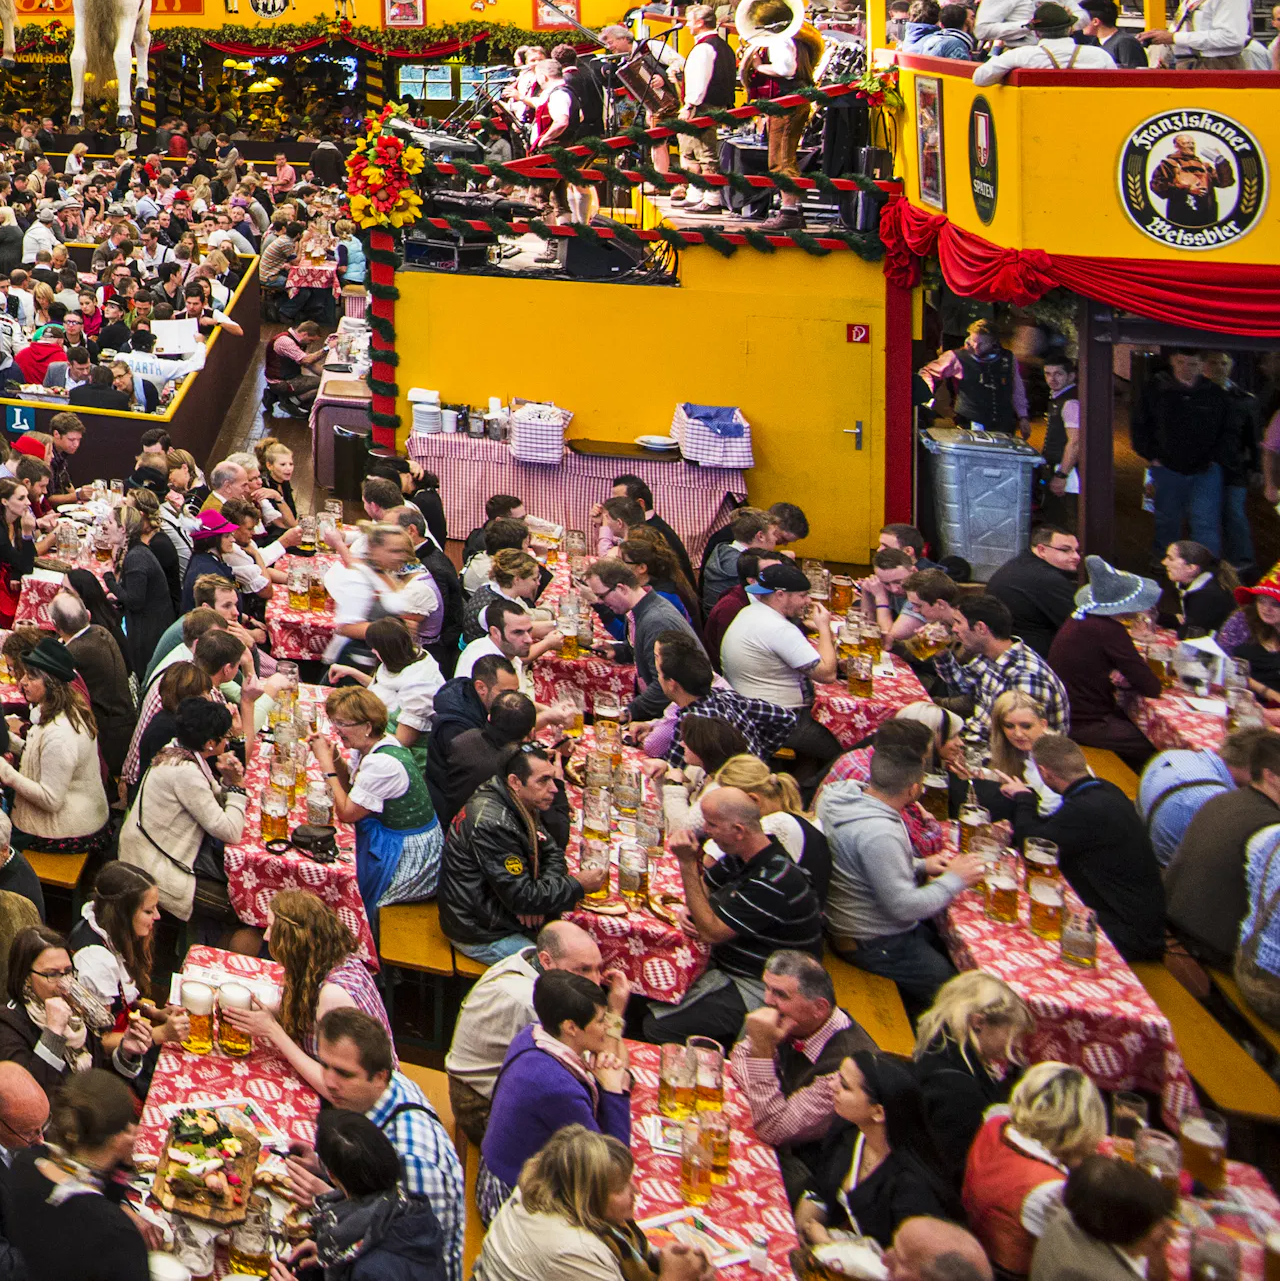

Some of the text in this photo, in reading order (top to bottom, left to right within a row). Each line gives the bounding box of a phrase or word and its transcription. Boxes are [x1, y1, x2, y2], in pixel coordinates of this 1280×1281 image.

[1131, 111, 1253, 153] Franziskaner
[972, 178, 995, 199] SPATEN
[1145, 216, 1242, 247] Weissbier
[11, 407, 30, 431] L
